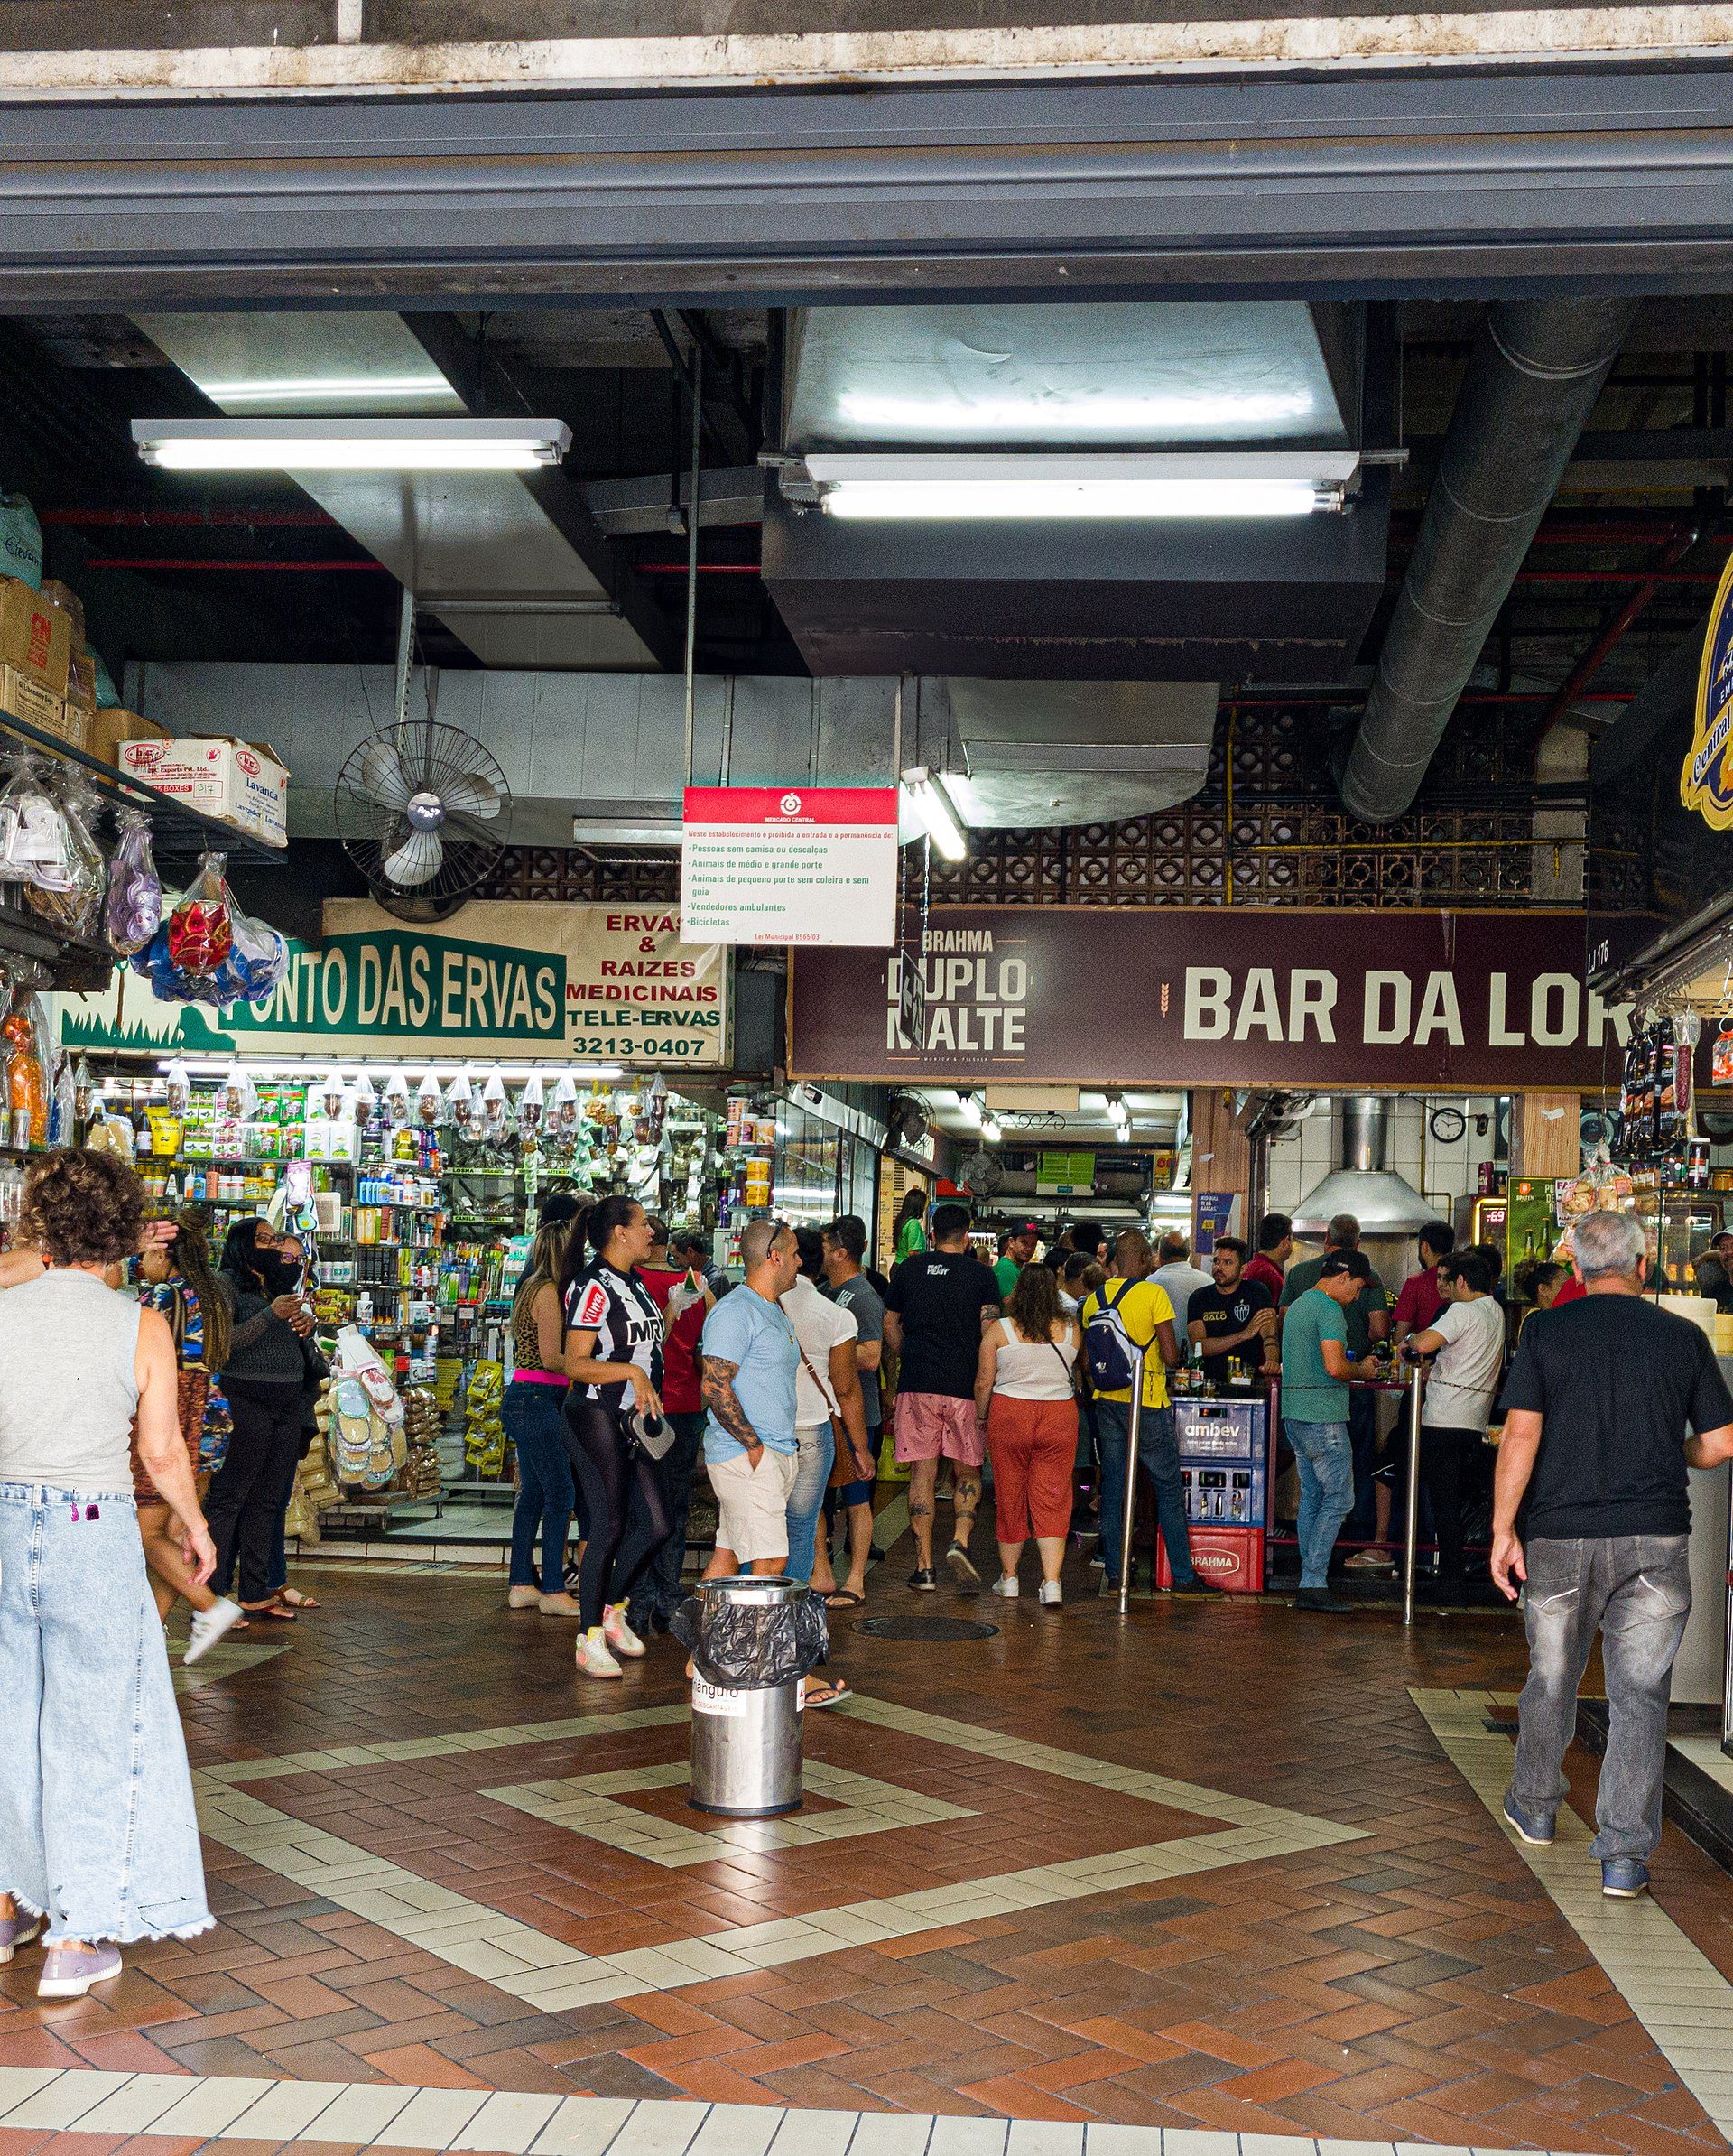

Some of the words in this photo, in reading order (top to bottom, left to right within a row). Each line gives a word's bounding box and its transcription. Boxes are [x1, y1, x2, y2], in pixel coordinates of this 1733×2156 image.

[1694, 705, 1732, 784] Central
[246, 777, 279, 802] Lavanda
[768, 831, 795, 840] proibida
[802, 831, 827, 839] entrada
[840, 831, 881, 840] permanência
[692, 844, 726, 854] Pessoas
[746, 845, 774, 854] camisa
[789, 845, 829, 856] descalças
[691, 860, 724, 869] Animais
[726, 860, 737, 869] de
[738, 860, 763, 869] médio
[771, 860, 800, 870] grande
[802, 861, 823, 870] porte
[691, 875, 724, 883] Animais
[726, 875, 736, 883] de
[738, 876, 771, 885] pequeno
[774, 876, 794, 885] porte
[816, 876, 843, 885] coleira
[691, 888, 709, 897] guia
[690, 903, 737, 912] Vendedores
[739, 903, 786, 912] ambulantes
[690, 917, 730, 926] Bicicletas
[638, 935, 657, 953] &
[755, 933, 764, 941] Lei
[922, 929, 994, 953] BRAHMA
[1587, 948, 1598, 975] LJ
[1598, 939, 1609, 966] 176
[601, 960, 696, 978] RAIZES
[217, 946, 348, 1026] NTO
[357, 943, 431, 1028] DAS
[440, 950, 557, 1030] ERVAS
[566, 983, 718, 1002] MEDICINAIS
[1183, 965, 1339, 1044] BAR
[1362, 969, 1466, 1046] DA
[1487, 971, 1662, 1048] LOR
[567, 1009, 720, 1027] TELE-ERVAS
[572, 1036, 705, 1056] 3213-0407
[1202, 1313, 1228, 1322] GALO
[1184, 1422, 1240, 1437] ambev
[1190, 1557, 1233, 1567] BRAHMA
